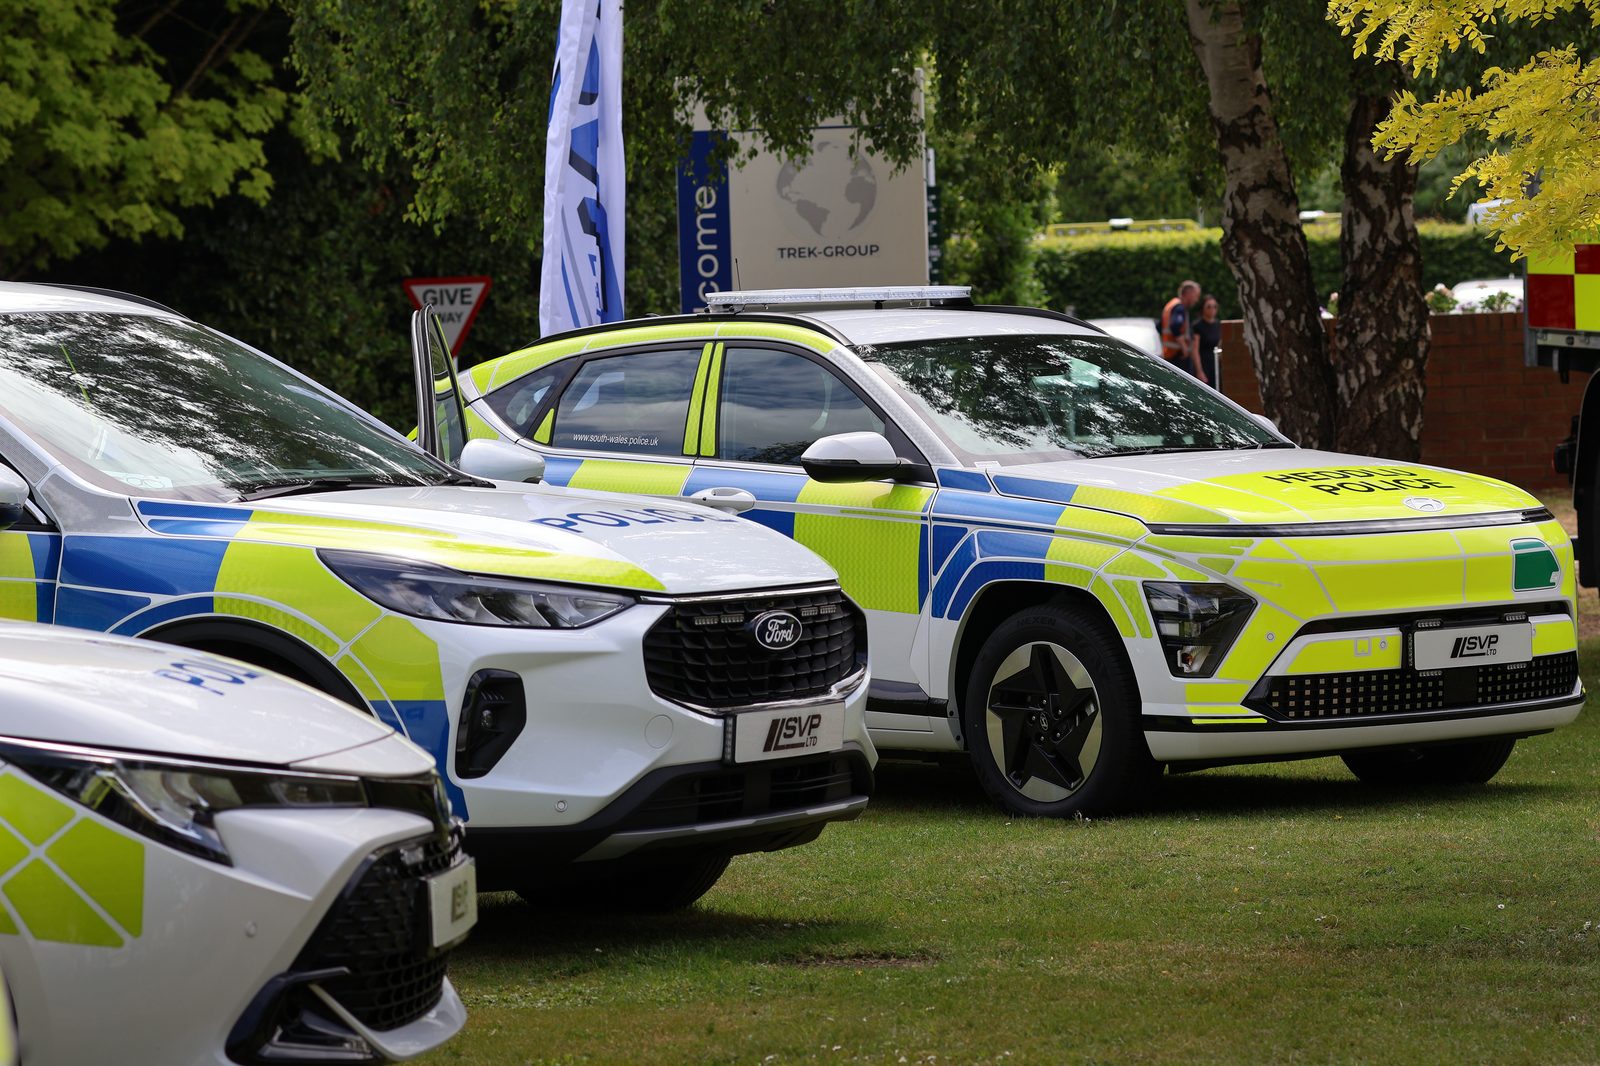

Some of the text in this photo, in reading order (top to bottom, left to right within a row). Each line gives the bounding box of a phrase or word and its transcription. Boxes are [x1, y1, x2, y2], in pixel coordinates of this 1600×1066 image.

[777, 244, 880, 259] TREK-GROUP
[422, 287, 473, 306] GIVE
[573, 433, 659, 446] www.south-wales.police.uk
[1310, 478, 1456, 496] POLICE
[765, 618, 794, 644] Ford
[1486, 648, 1497, 656] LTD
[805, 736, 818, 748] LTD
